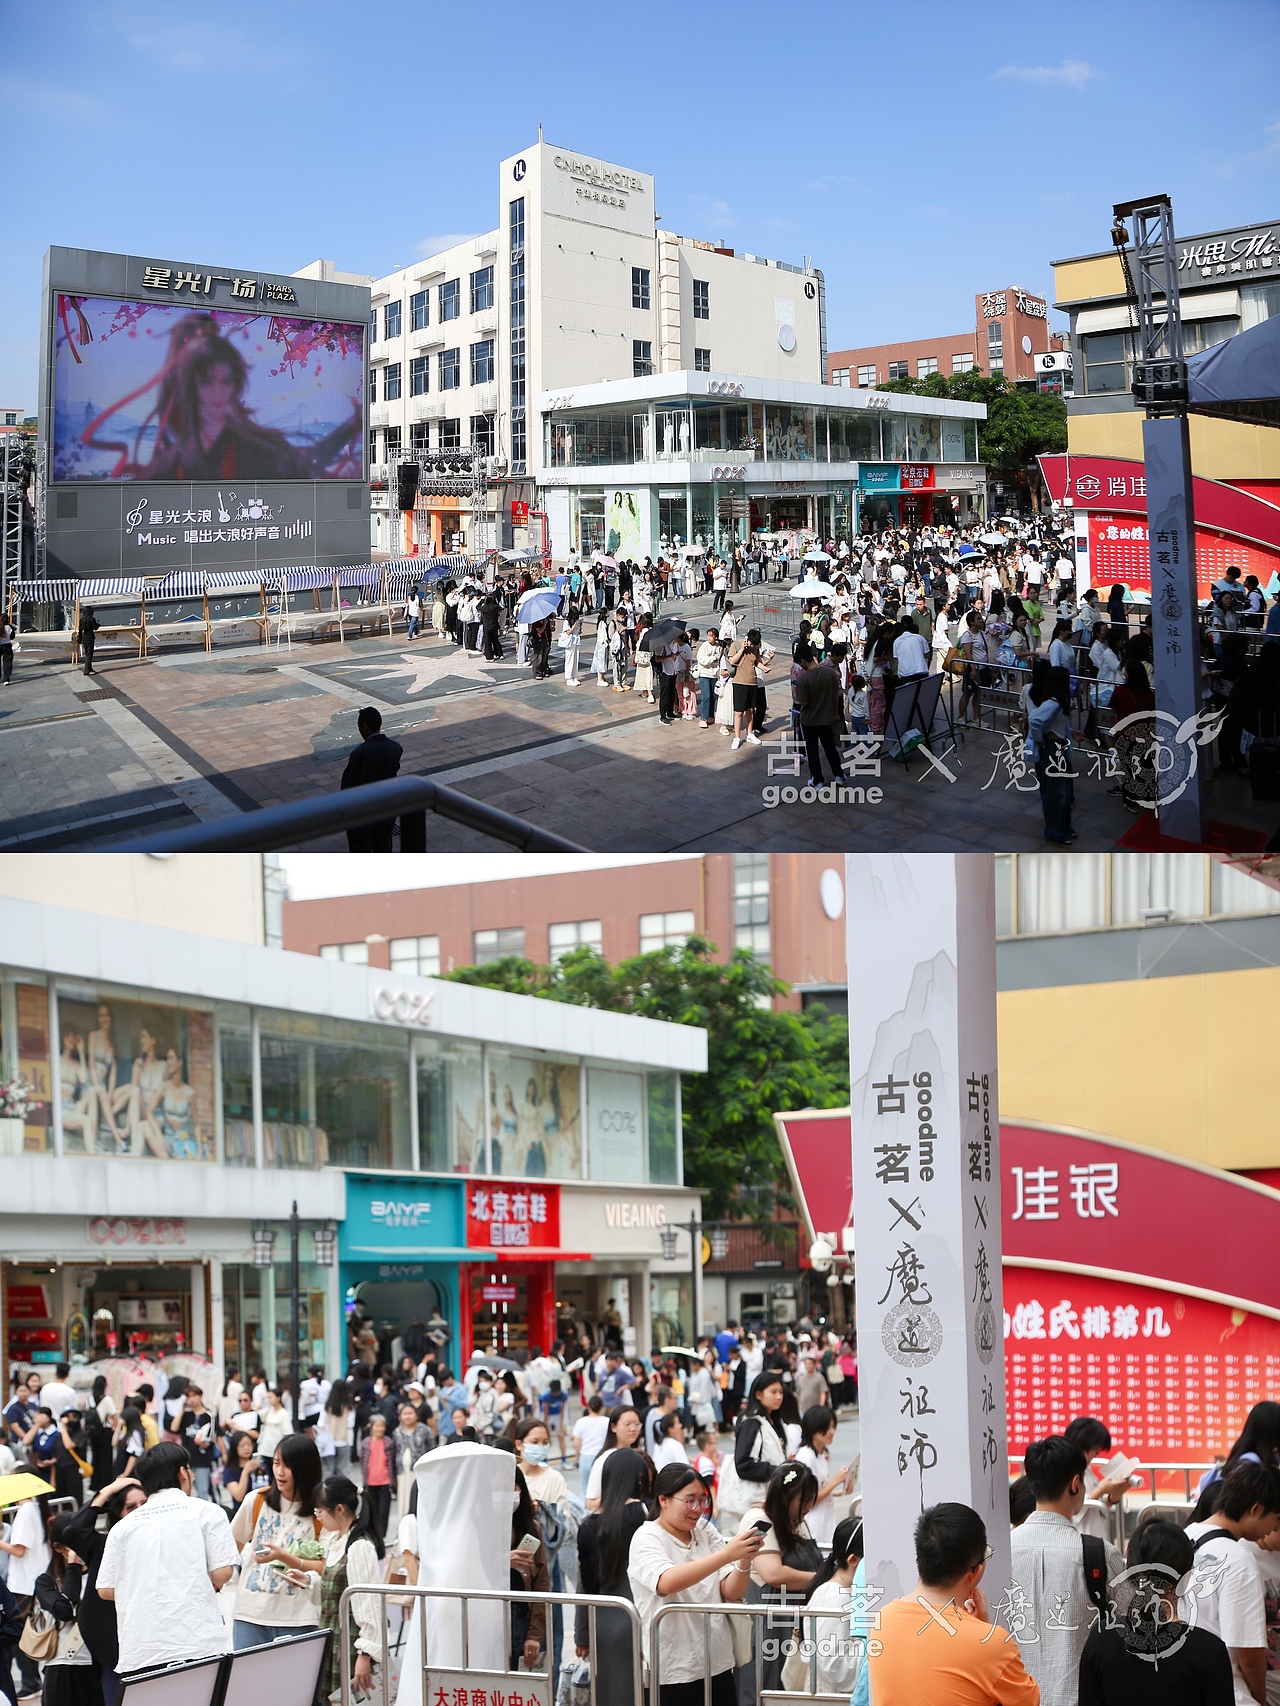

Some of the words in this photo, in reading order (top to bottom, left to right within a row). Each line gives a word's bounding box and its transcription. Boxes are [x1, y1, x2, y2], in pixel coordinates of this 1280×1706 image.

[602, 168, 644, 191] HOTEL
[1179, 241, 1226, 270] 米思
[142, 266, 257, 298] 星光广场
[267, 283, 292, 293] STARS
[267, 291, 295, 301] PLAZA
[982, 292, 1006, 306] 木屋
[1015, 291, 1047, 319] 木屋烧烤
[984, 304, 1006, 318] 烧烤
[149, 509, 213, 525] 星光大浪
[137, 532, 177, 546] Music
[184, 526, 280, 544] 唱出大浪好声音
[1106, 525, 1149, 541] 您的姓
[1156, 529, 1171, 565] 古茗
[1171, 529, 1180, 565] goodme
[872, 1074, 911, 1184] 古茗
[913, 1071, 938, 1182] goodme
[966, 1072, 983, 1182] 古茗
[981, 1074, 992, 1183] goodme
[1011, 1162, 1119, 1221] 佳银
[470, 1190, 547, 1223] 北京布鞋
[604, 1203, 666, 1228] VIEAING
[434, 1686, 542, 1706] 大浪商业中心
